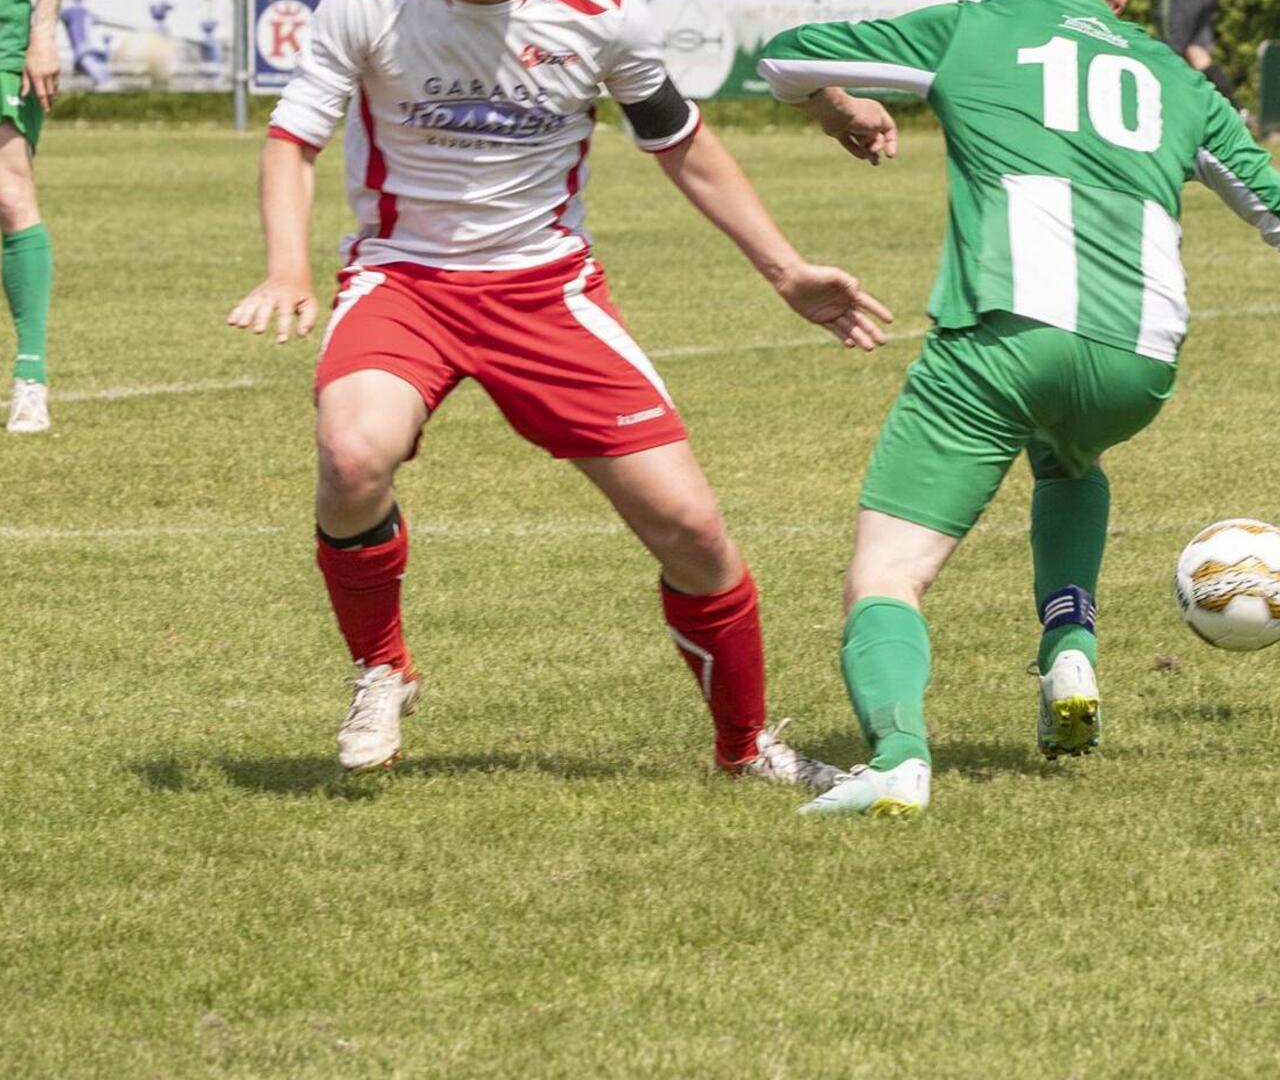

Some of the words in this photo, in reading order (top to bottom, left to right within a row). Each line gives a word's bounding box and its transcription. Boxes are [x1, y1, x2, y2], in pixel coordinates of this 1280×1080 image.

[269, 21, 306, 57] K
[424, 77, 548, 104] GARAGE
[1017, 36, 1163, 153] 10
